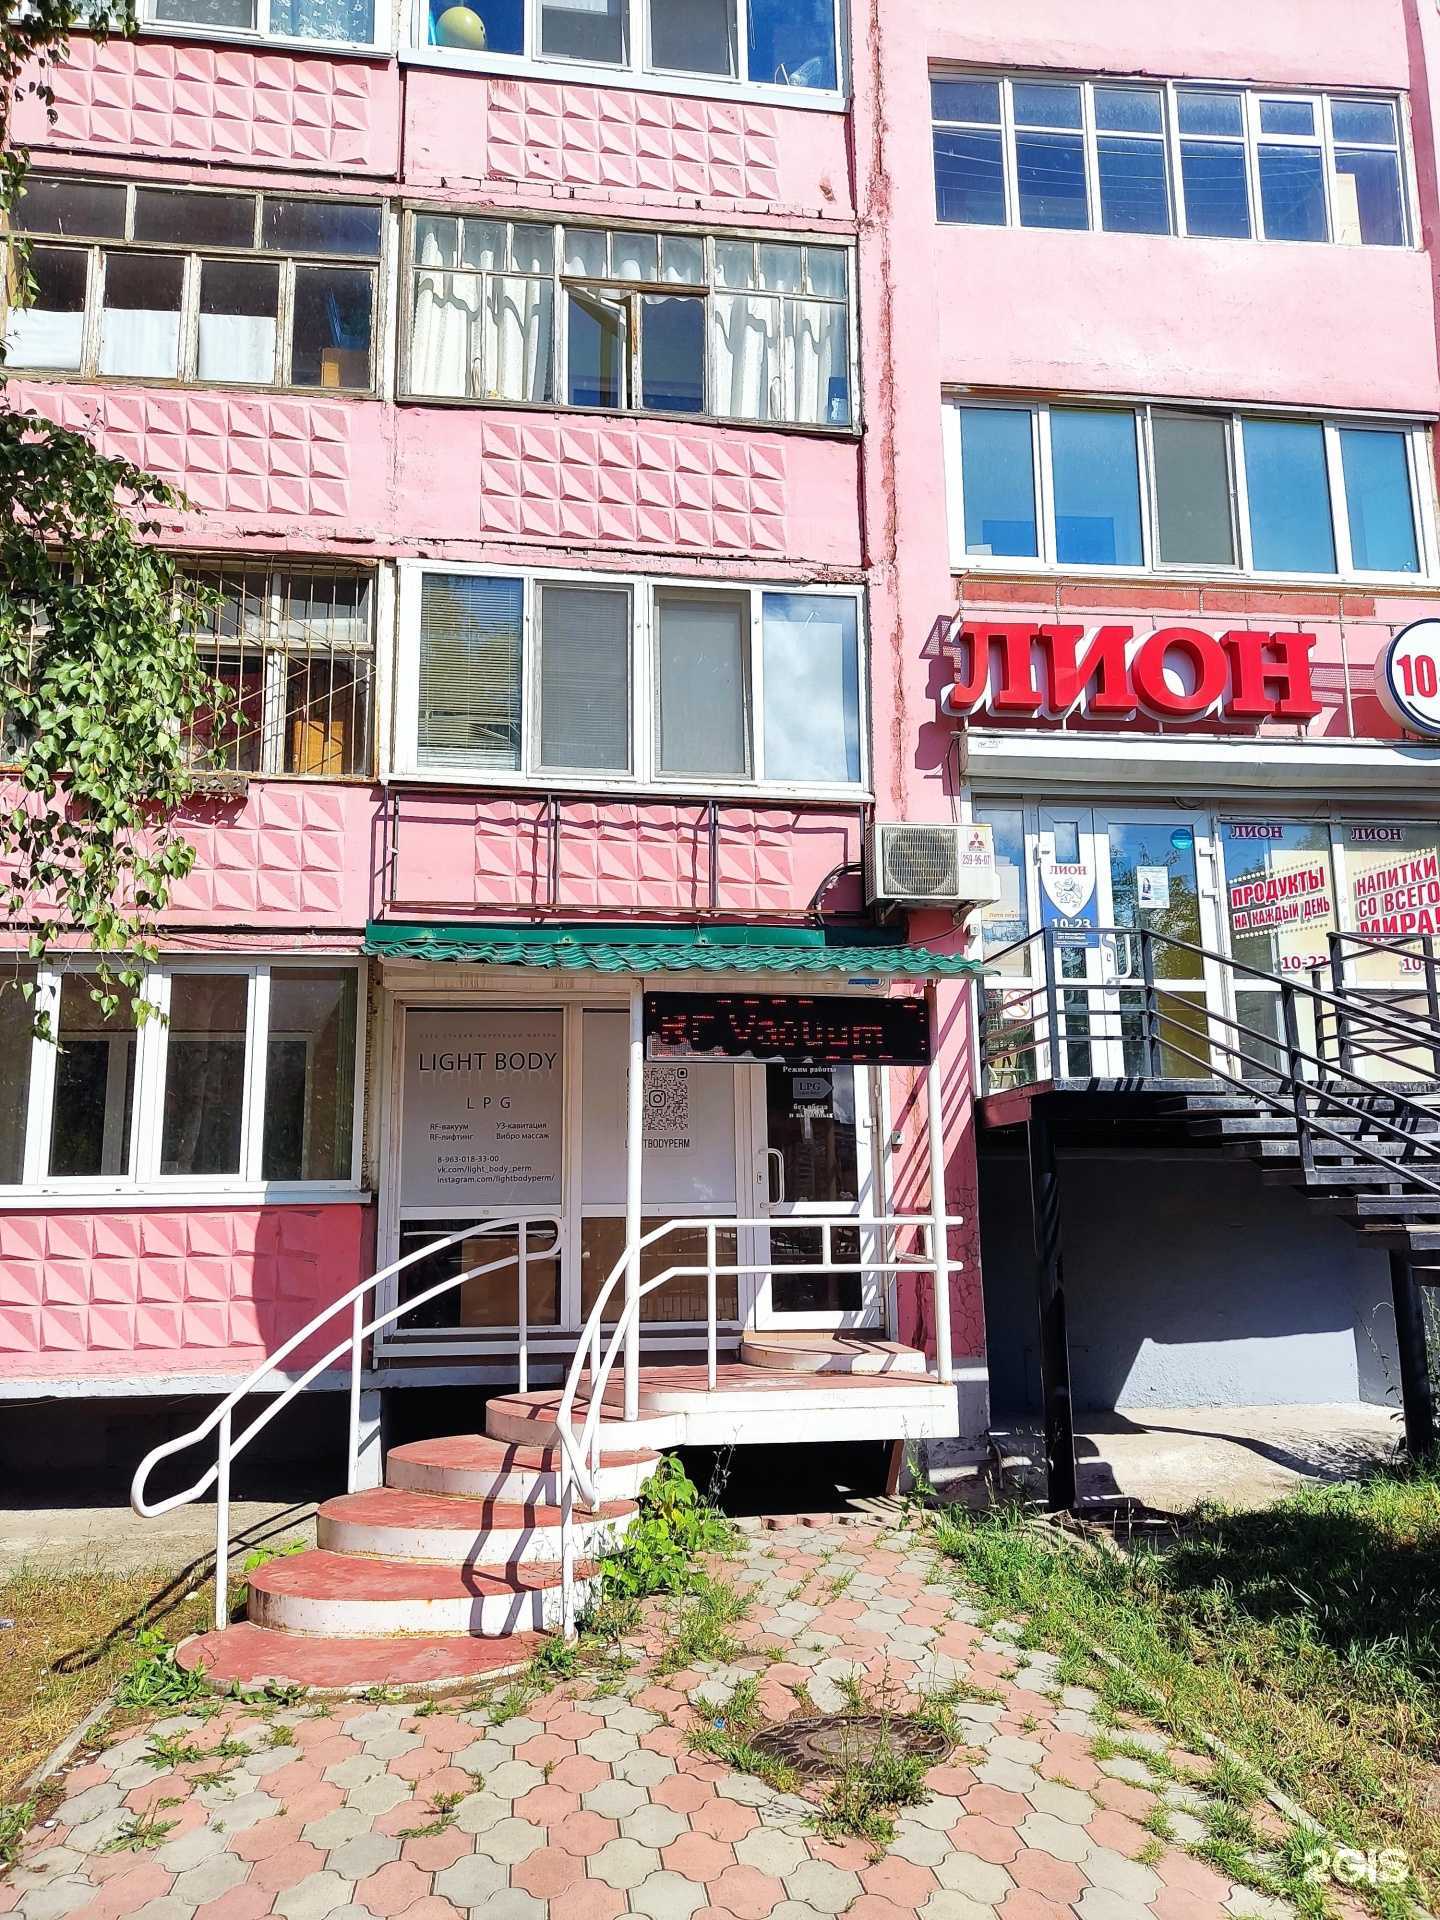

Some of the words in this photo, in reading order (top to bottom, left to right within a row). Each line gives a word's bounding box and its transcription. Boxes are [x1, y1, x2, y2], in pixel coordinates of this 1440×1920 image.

[950, 621, 1322, 718] ЛИОН
[1231, 825, 1283, 839] ЛИОН
[1351, 827, 1402, 841] ЛИОН
[1049, 865, 1087, 875] ЛИОН
[1356, 855, 1438, 897] НАПИТКИ
[1231, 866, 1325, 908] ПРОДУКТЫ
[1358, 898, 1377, 918] СО
[1383, 880, 1440, 913] ВСЕГО
[1234, 914, 1248, 929] НА
[1251, 902, 1299, 925] КАЖДЫЙ
[1303, 896, 1330, 919] ДЕНЬ
[1359, 906, 1440, 941] МИРА!
[419, 1052, 487, 1071] LIGHT
[495, 1052, 558, 1071] BODY
[782, 1065, 808, 1073] Режим
[809, 1065, 837, 1074] работы
[496, 1122, 547, 1130] УЗ-кавитация
[496, 1132, 520, 1140] Вибро
[624, 1138, 690, 1149] LTBODYPERM
